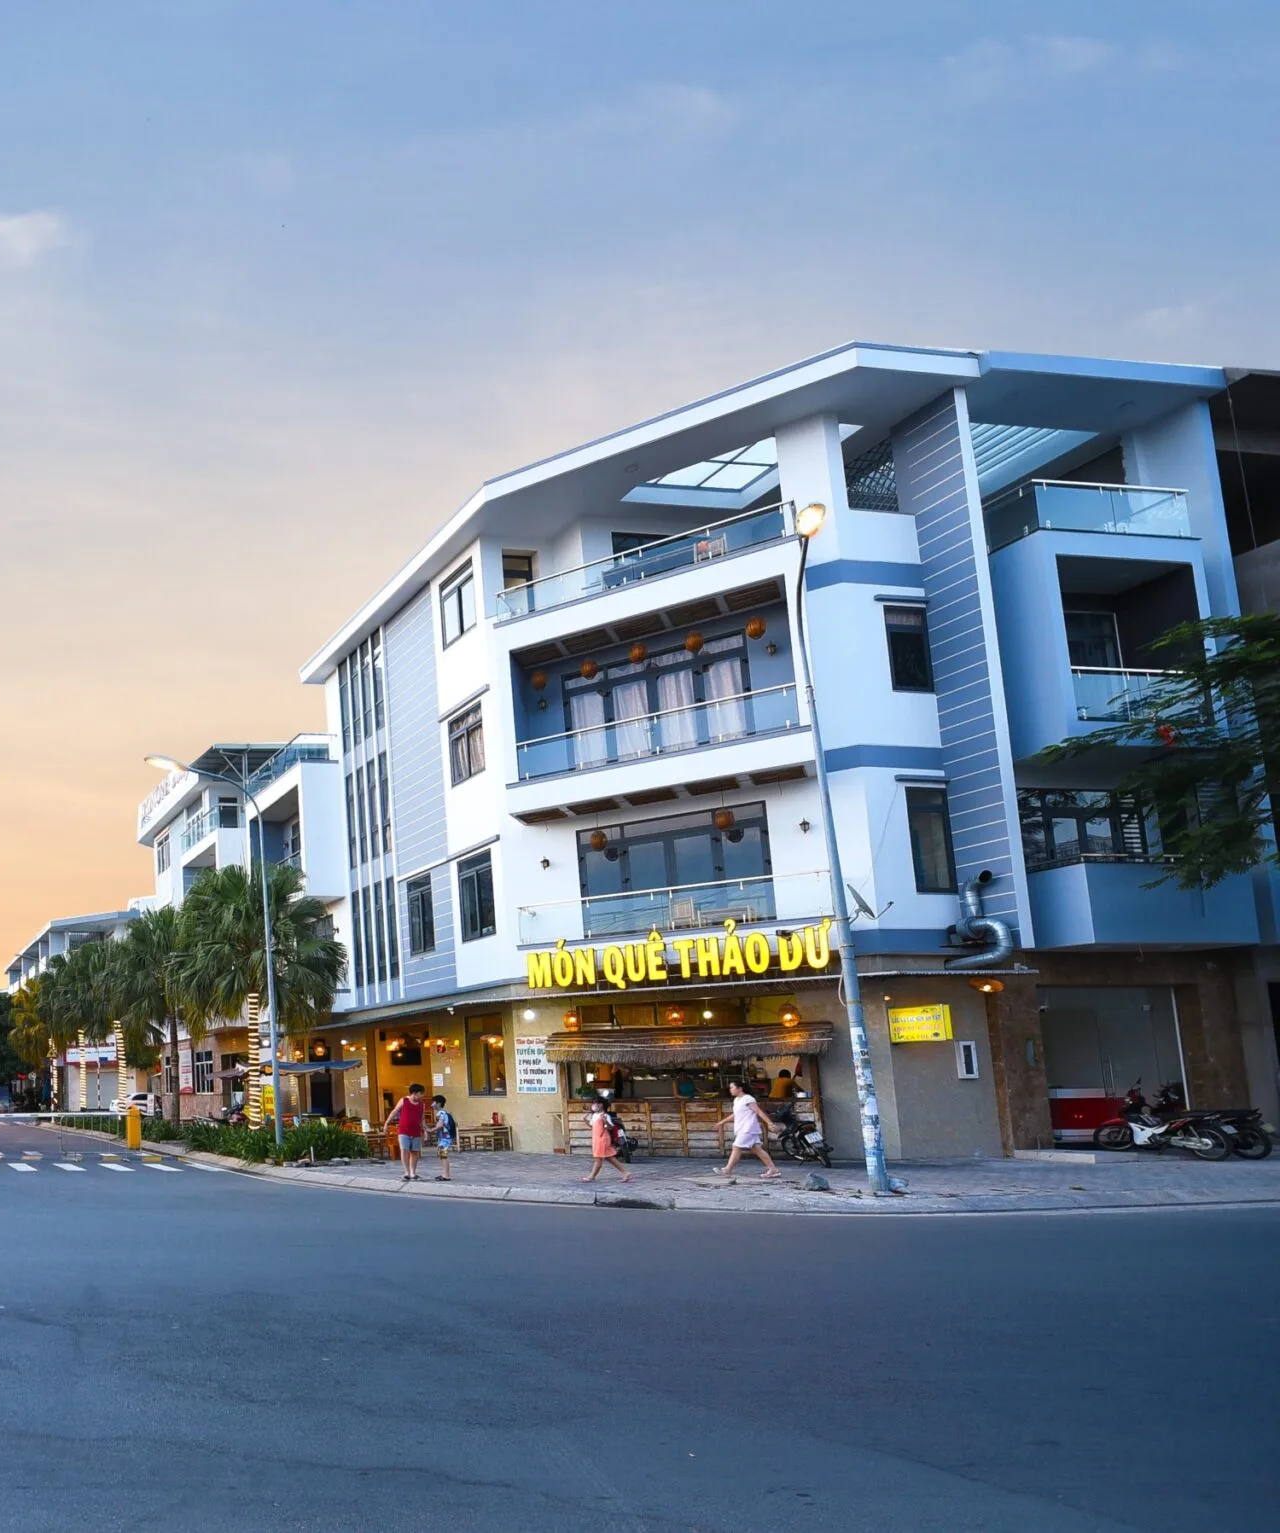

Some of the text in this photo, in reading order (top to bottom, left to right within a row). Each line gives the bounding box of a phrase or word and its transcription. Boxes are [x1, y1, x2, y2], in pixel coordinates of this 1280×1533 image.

[526, 918, 832, 989] MÓN QUÊ THẢO DƯ
